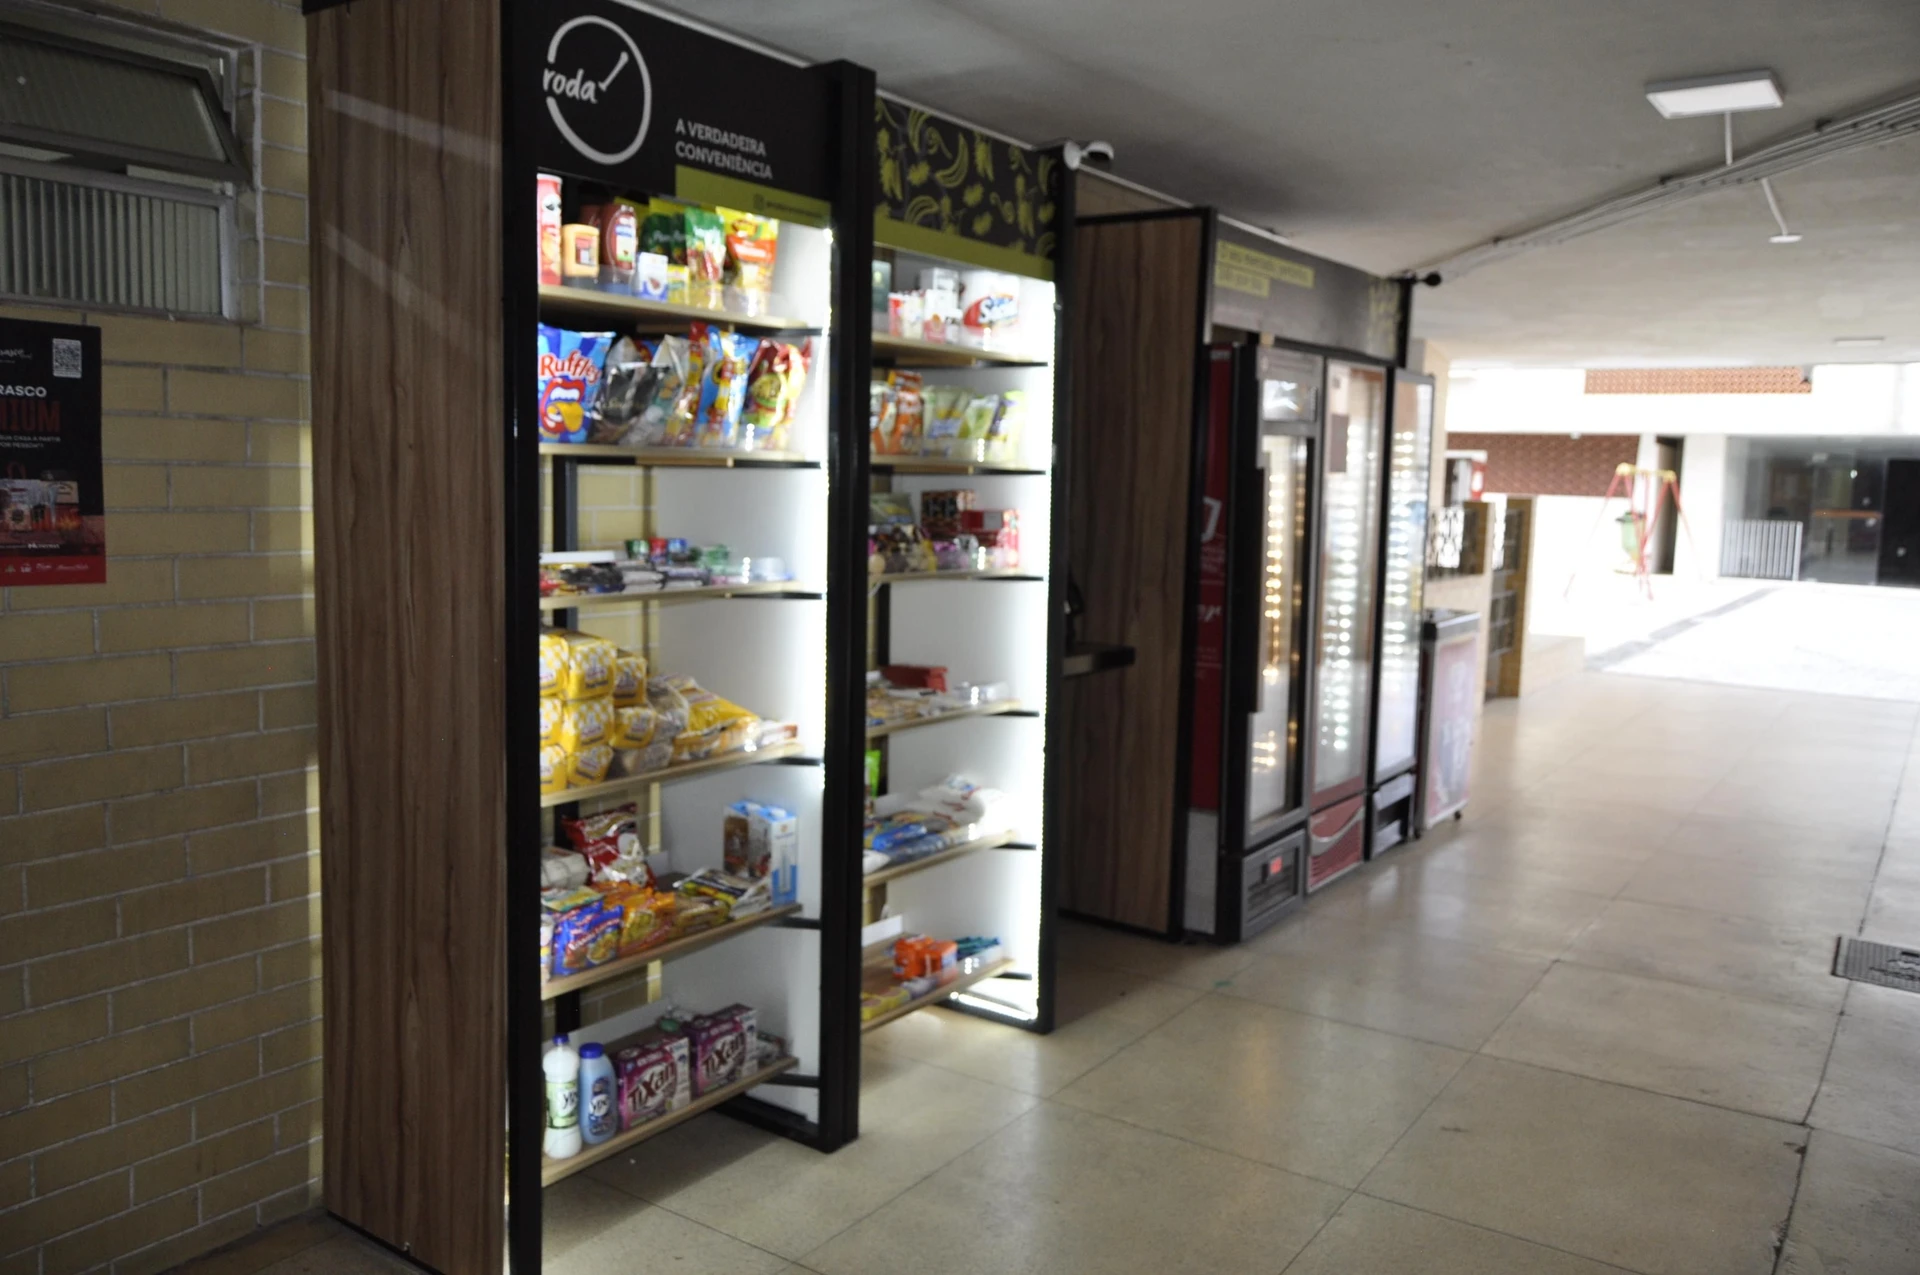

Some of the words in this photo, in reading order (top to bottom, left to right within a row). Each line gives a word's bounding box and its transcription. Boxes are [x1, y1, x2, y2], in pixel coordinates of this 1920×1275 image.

[543, 67, 598, 104] roda
[675, 118, 687, 135] A
[687, 120, 767, 157] VERDADEIRA
[675, 141, 773, 180] CONVENIÊNCIA
[539, 350, 601, 384] Ruffles
